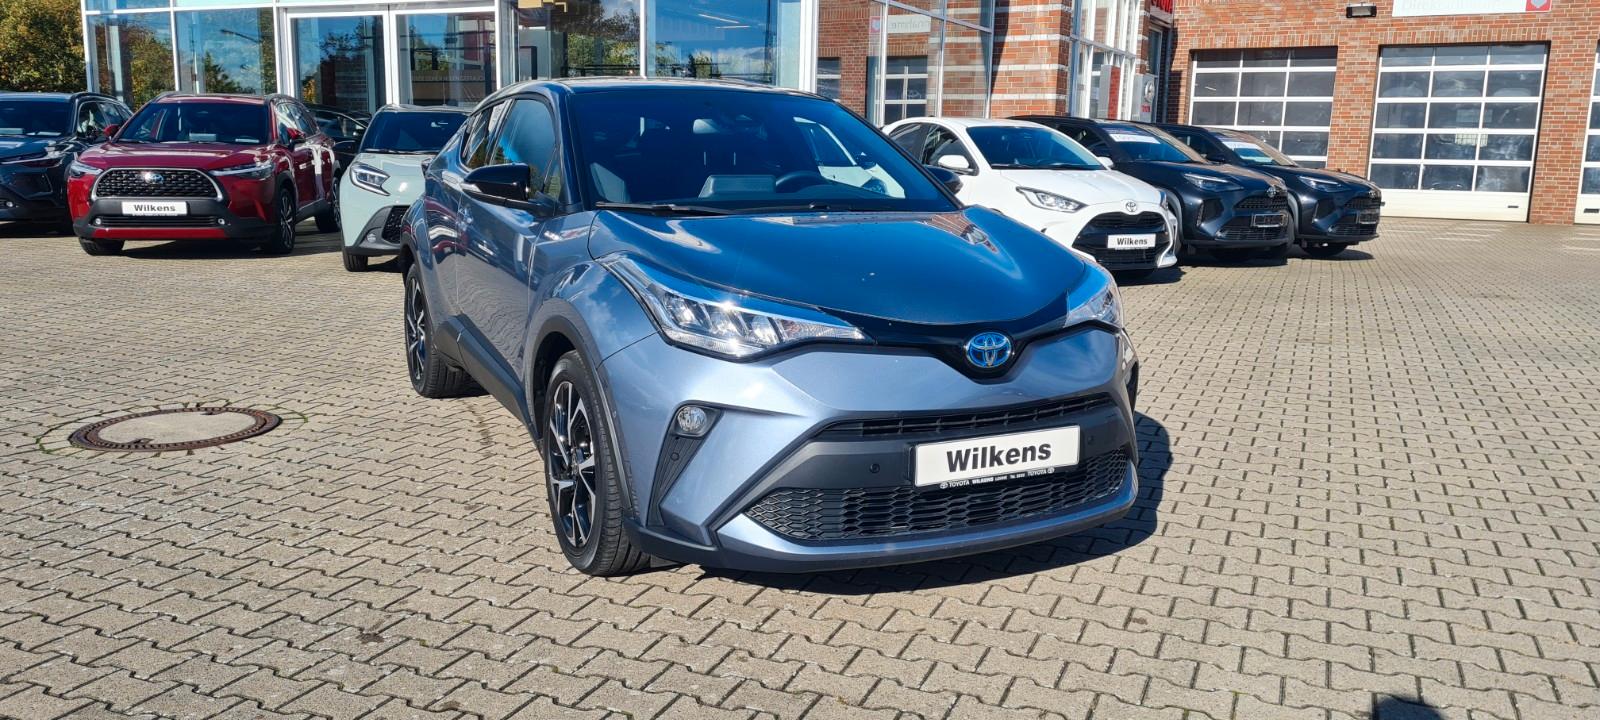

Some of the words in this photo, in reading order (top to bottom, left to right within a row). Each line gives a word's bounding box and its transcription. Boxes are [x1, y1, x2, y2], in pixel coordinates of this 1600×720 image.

[133, 204, 176, 212] Wilkens
[1116, 237, 1148, 246] Wilkens
[946, 443, 1051, 473] Wilkens
